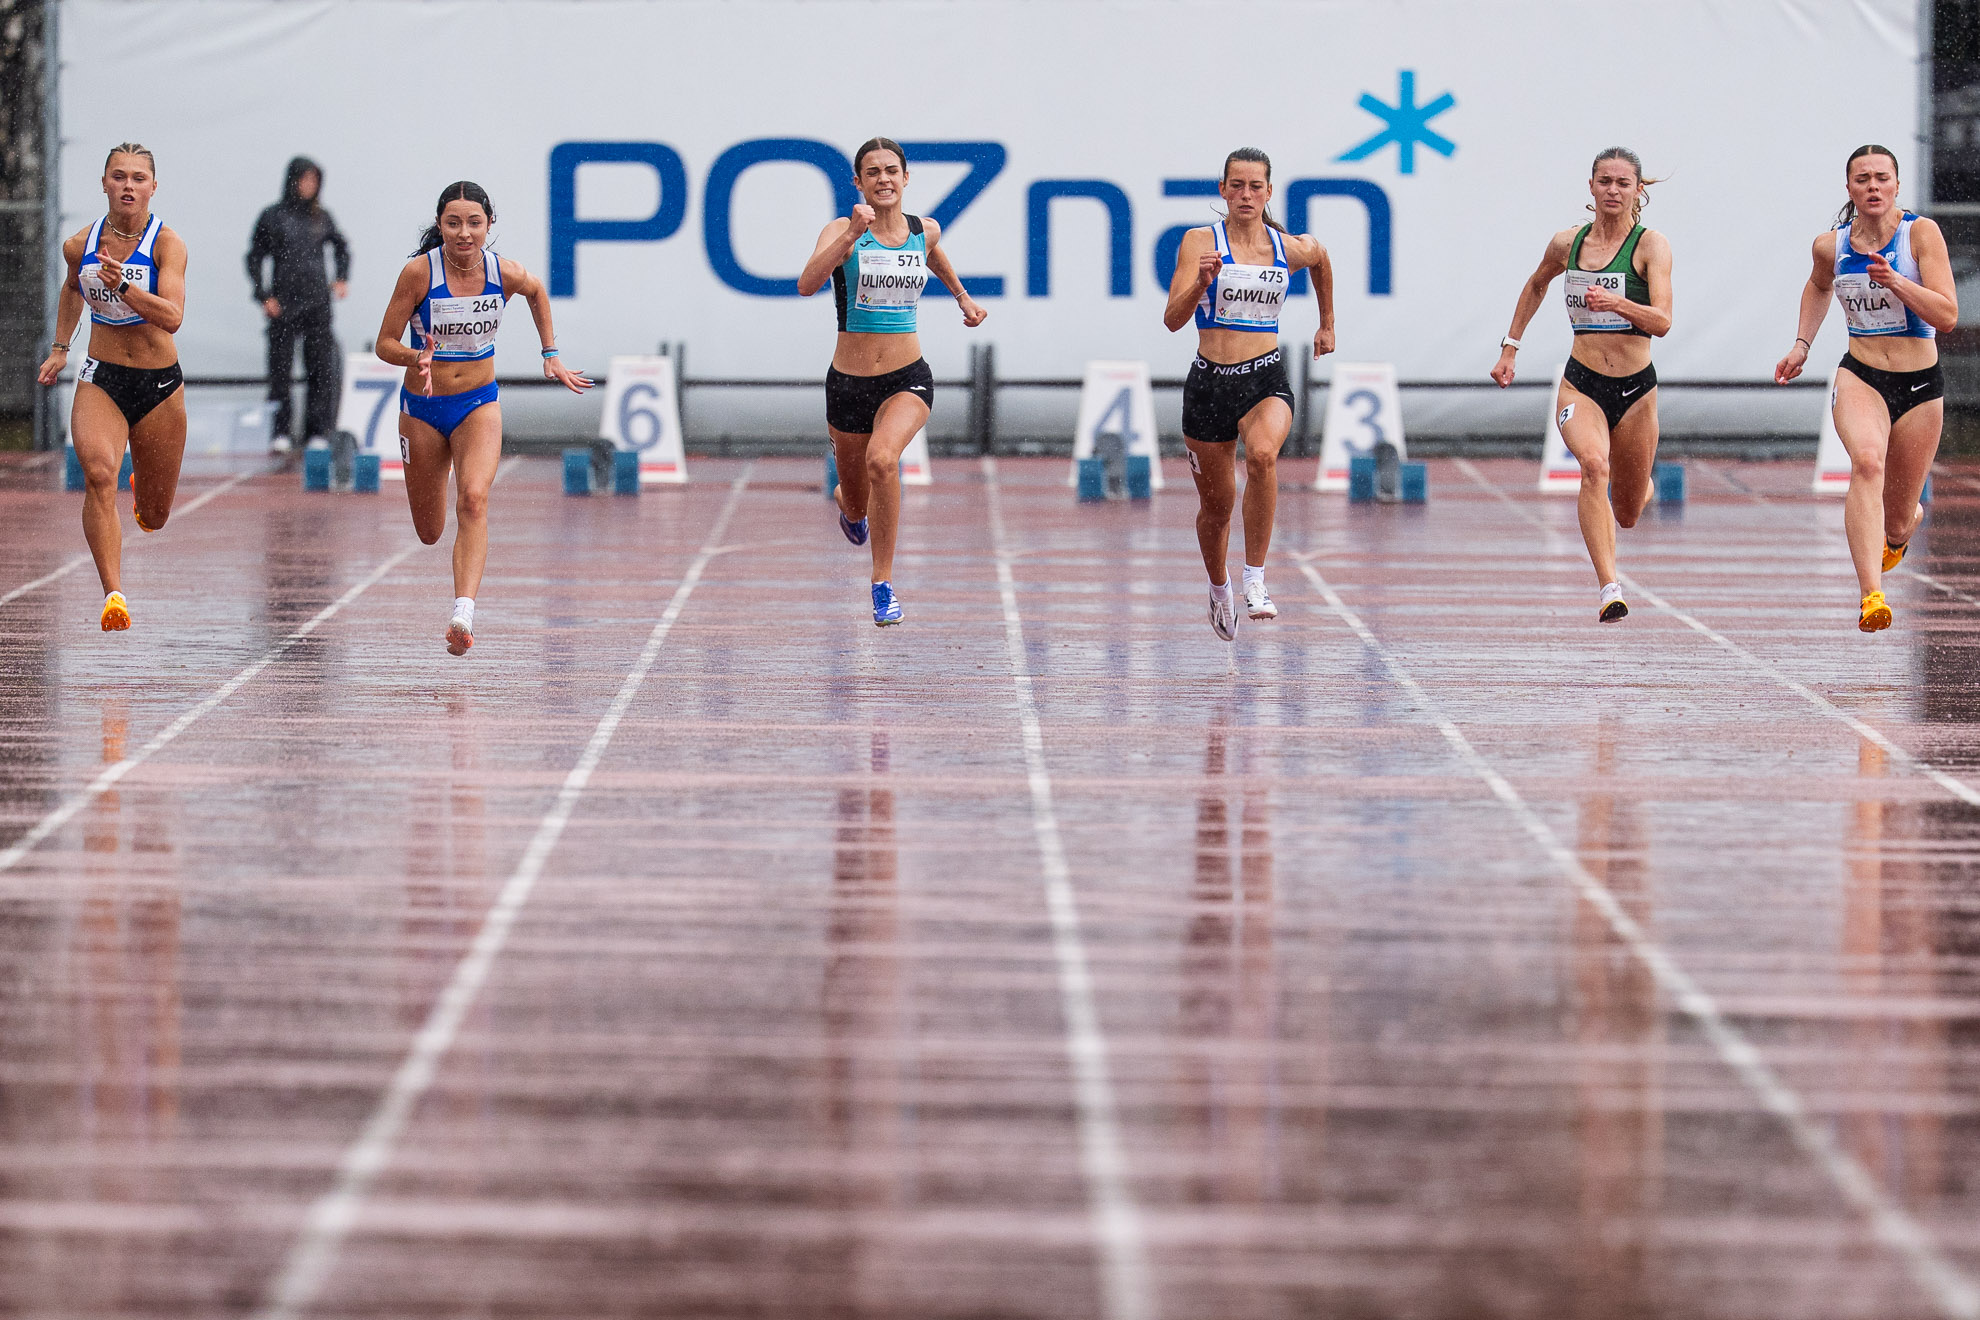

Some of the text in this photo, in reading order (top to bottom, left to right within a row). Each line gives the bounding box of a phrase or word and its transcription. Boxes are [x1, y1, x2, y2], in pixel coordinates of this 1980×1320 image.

[898, 254, 921, 267] 571
[861, 274, 924, 289] ULIKOWSKA
[1259, 270, 1283, 284] 475
[1595, 277, 1619, 289] 428
[1222, 287, 1281, 305] GAWLIK
[1566, 294, 1588, 308] GRU
[1845, 295, 1891, 312] ŻYLLA
[472, 298, 498, 313] 264
[432, 319, 498, 336] NIEZGODA
[1213, 351, 1281, 376] NIKE PRO
[354, 380, 398, 448] 7
[619, 382, 661, 452] 6
[1093, 386, 1140, 455] 4
[1560, 408, 1569, 426] 3
[1343, 389, 1385, 459] 3
[400, 437, 407, 459] 6
